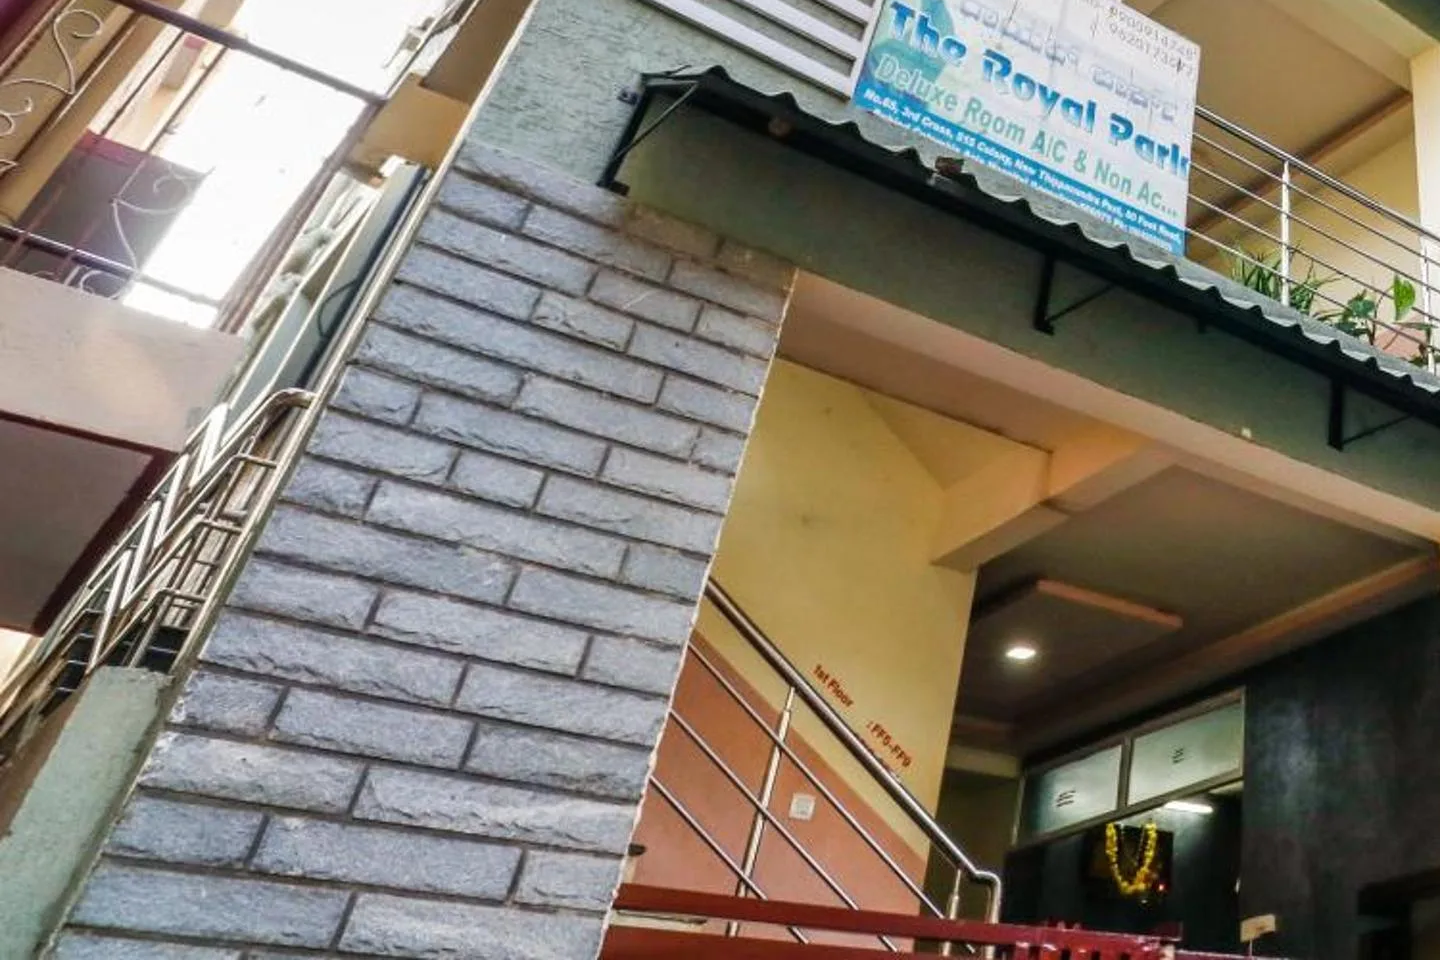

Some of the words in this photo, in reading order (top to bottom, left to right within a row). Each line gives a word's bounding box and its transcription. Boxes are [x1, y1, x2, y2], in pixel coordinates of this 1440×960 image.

[875, 51, 958, 112] Deluxe
[963, 88, 1026, 145] Room
[1074, 151, 1088, 174] &
[1095, 156, 1132, 196] Non
[890, 0, 967, 65] The
[981, 48, 1097, 134] Royal
[827, 678, 854, 707] Floor
